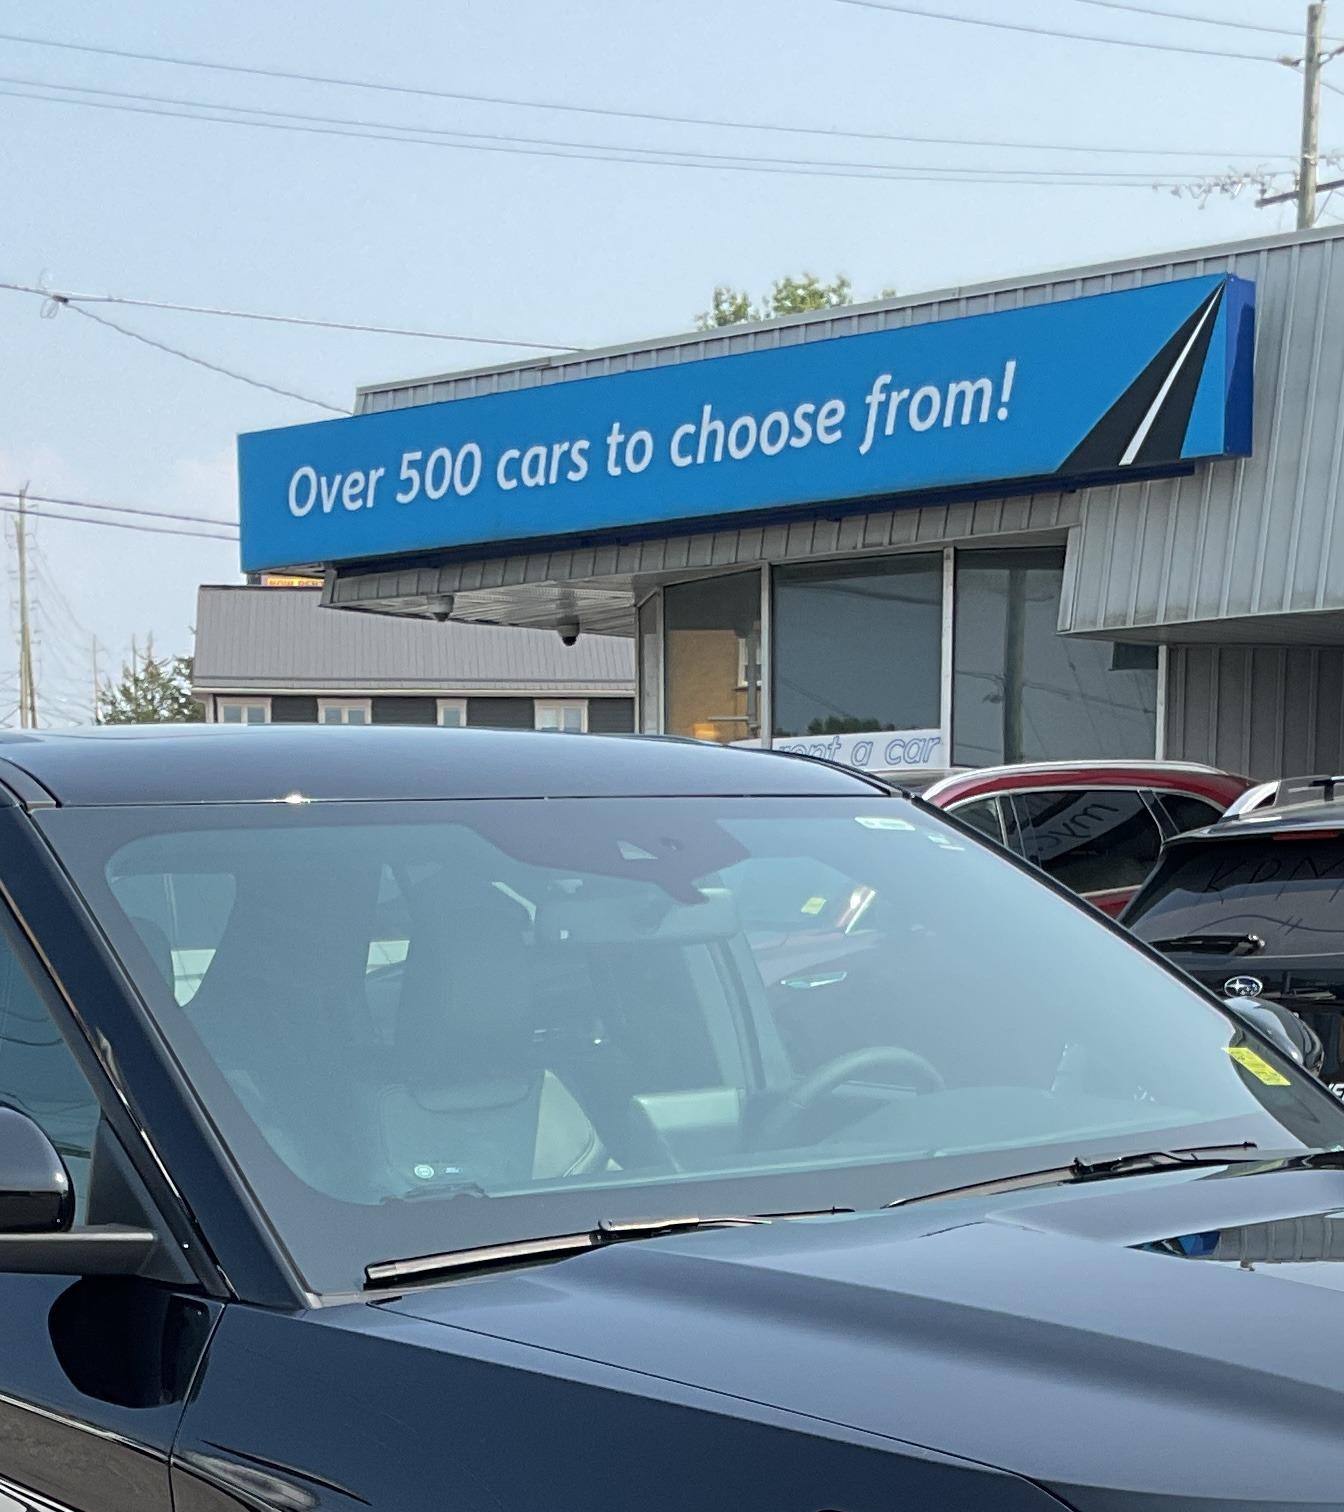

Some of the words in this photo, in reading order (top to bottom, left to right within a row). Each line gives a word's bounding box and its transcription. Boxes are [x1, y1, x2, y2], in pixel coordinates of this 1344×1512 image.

[288, 465, 385, 517] Over
[396, 443, 482, 504] 500
[496, 439, 590, 490] cars
[606, 422, 654, 477] to
[670, 399, 846, 468] choose
[859, 359, 1017, 456] from!
[850, 740, 874, 767] a
[885, 737, 941, 766] car
